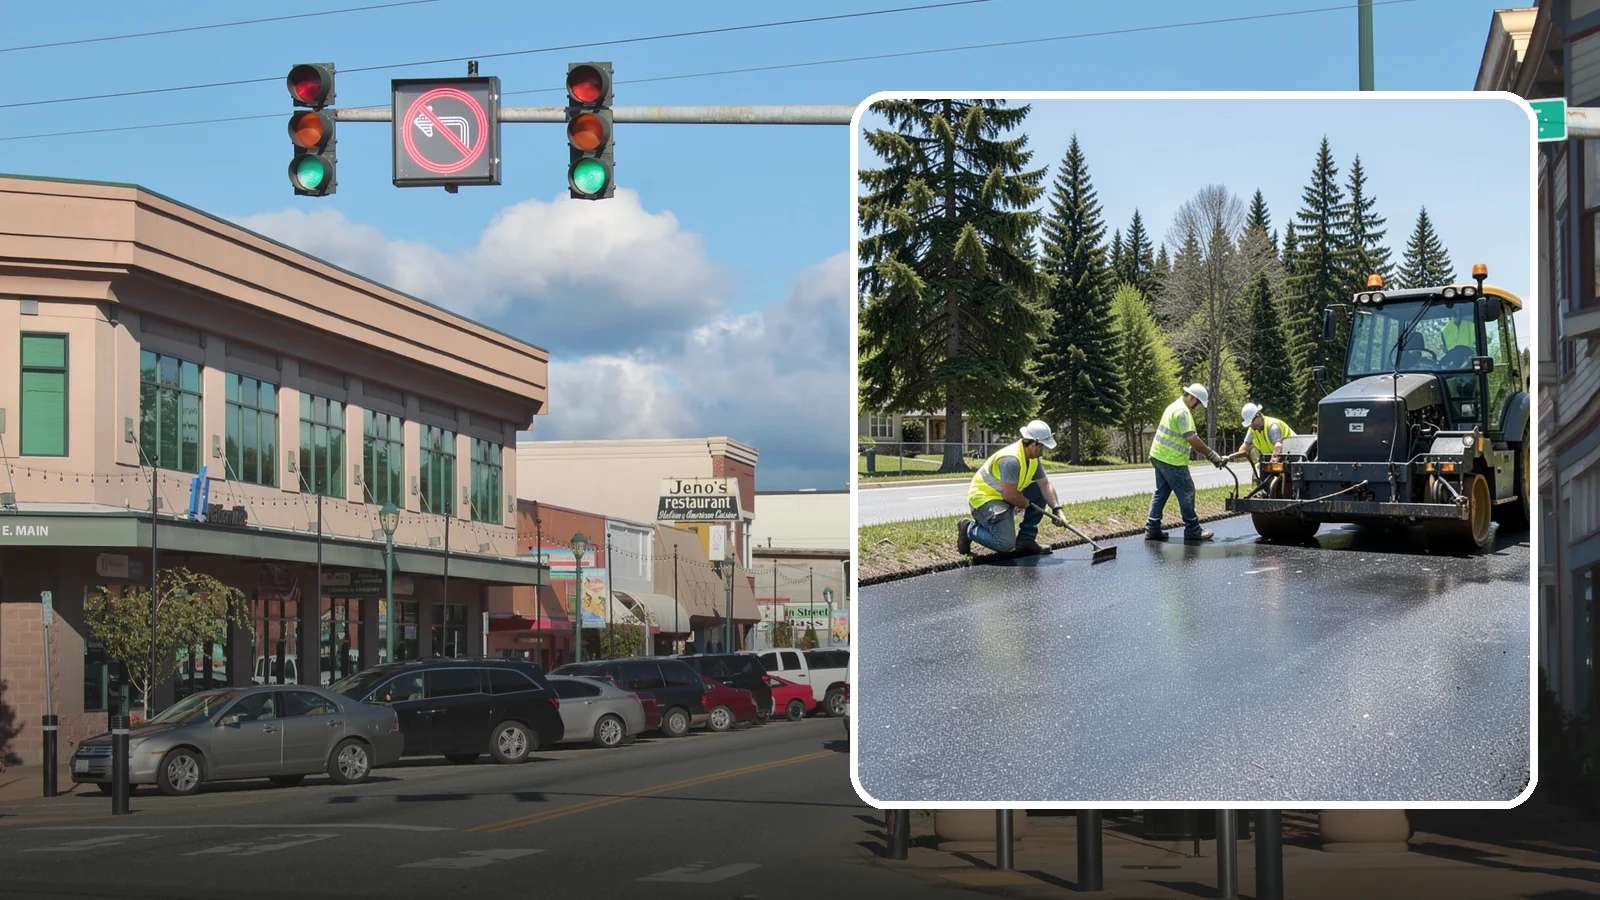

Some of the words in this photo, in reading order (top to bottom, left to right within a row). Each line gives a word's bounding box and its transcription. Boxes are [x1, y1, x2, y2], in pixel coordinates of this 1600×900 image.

[670, 480, 728, 494] Jeno's
[665, 497, 731, 509] restaurant
[686, 510, 715, 520] American
[715, 510, 737, 520] Cuisine
[2, 525, 13, 536] E.
[15, 525, 49, 536] MAIN
[797, 607, 828, 617] Street
